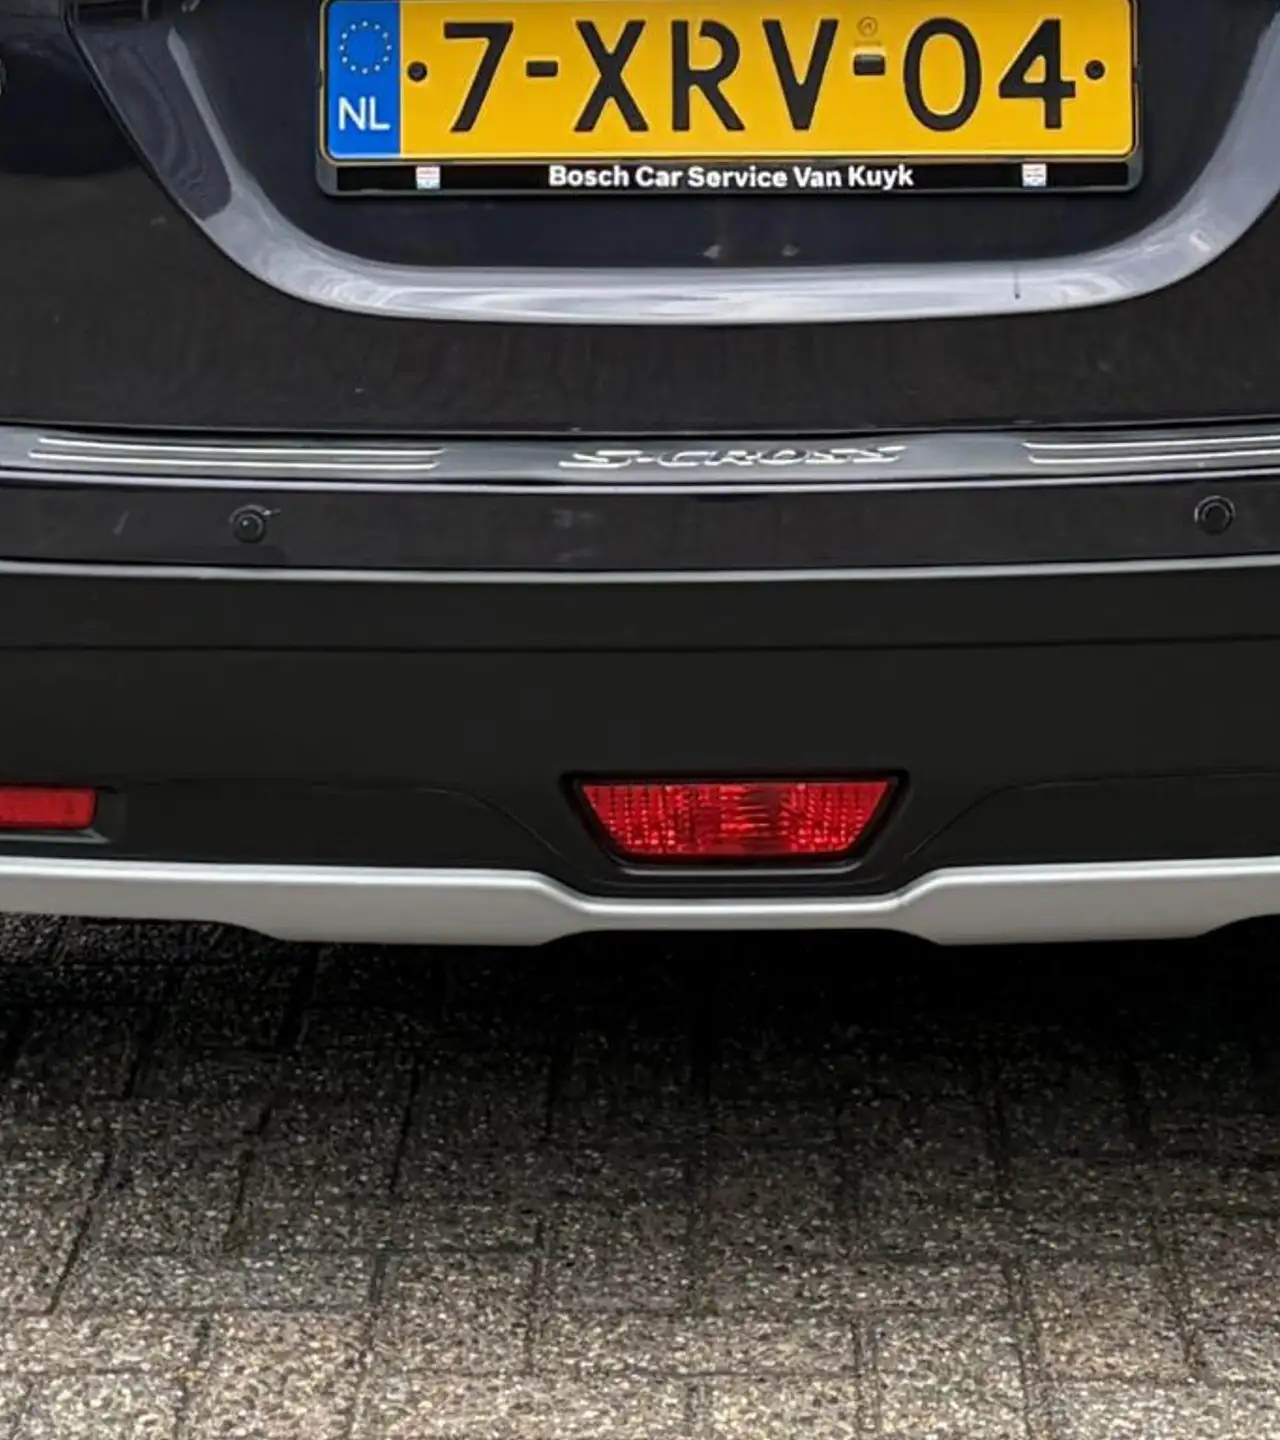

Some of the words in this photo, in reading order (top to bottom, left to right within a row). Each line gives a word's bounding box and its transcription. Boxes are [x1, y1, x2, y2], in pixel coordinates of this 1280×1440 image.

[443, 17, 1076, 134] 7-XRV-04
[337, 96, 391, 131] NL
[548, 164, 629, 187] Bosch
[635, 166, 683, 187] Car
[687, 164, 787, 187] Service
[793, 165, 842, 187] Van
[847, 164, 914, 191] Kuyk
[558, 446, 907, 469] S-CROSS
